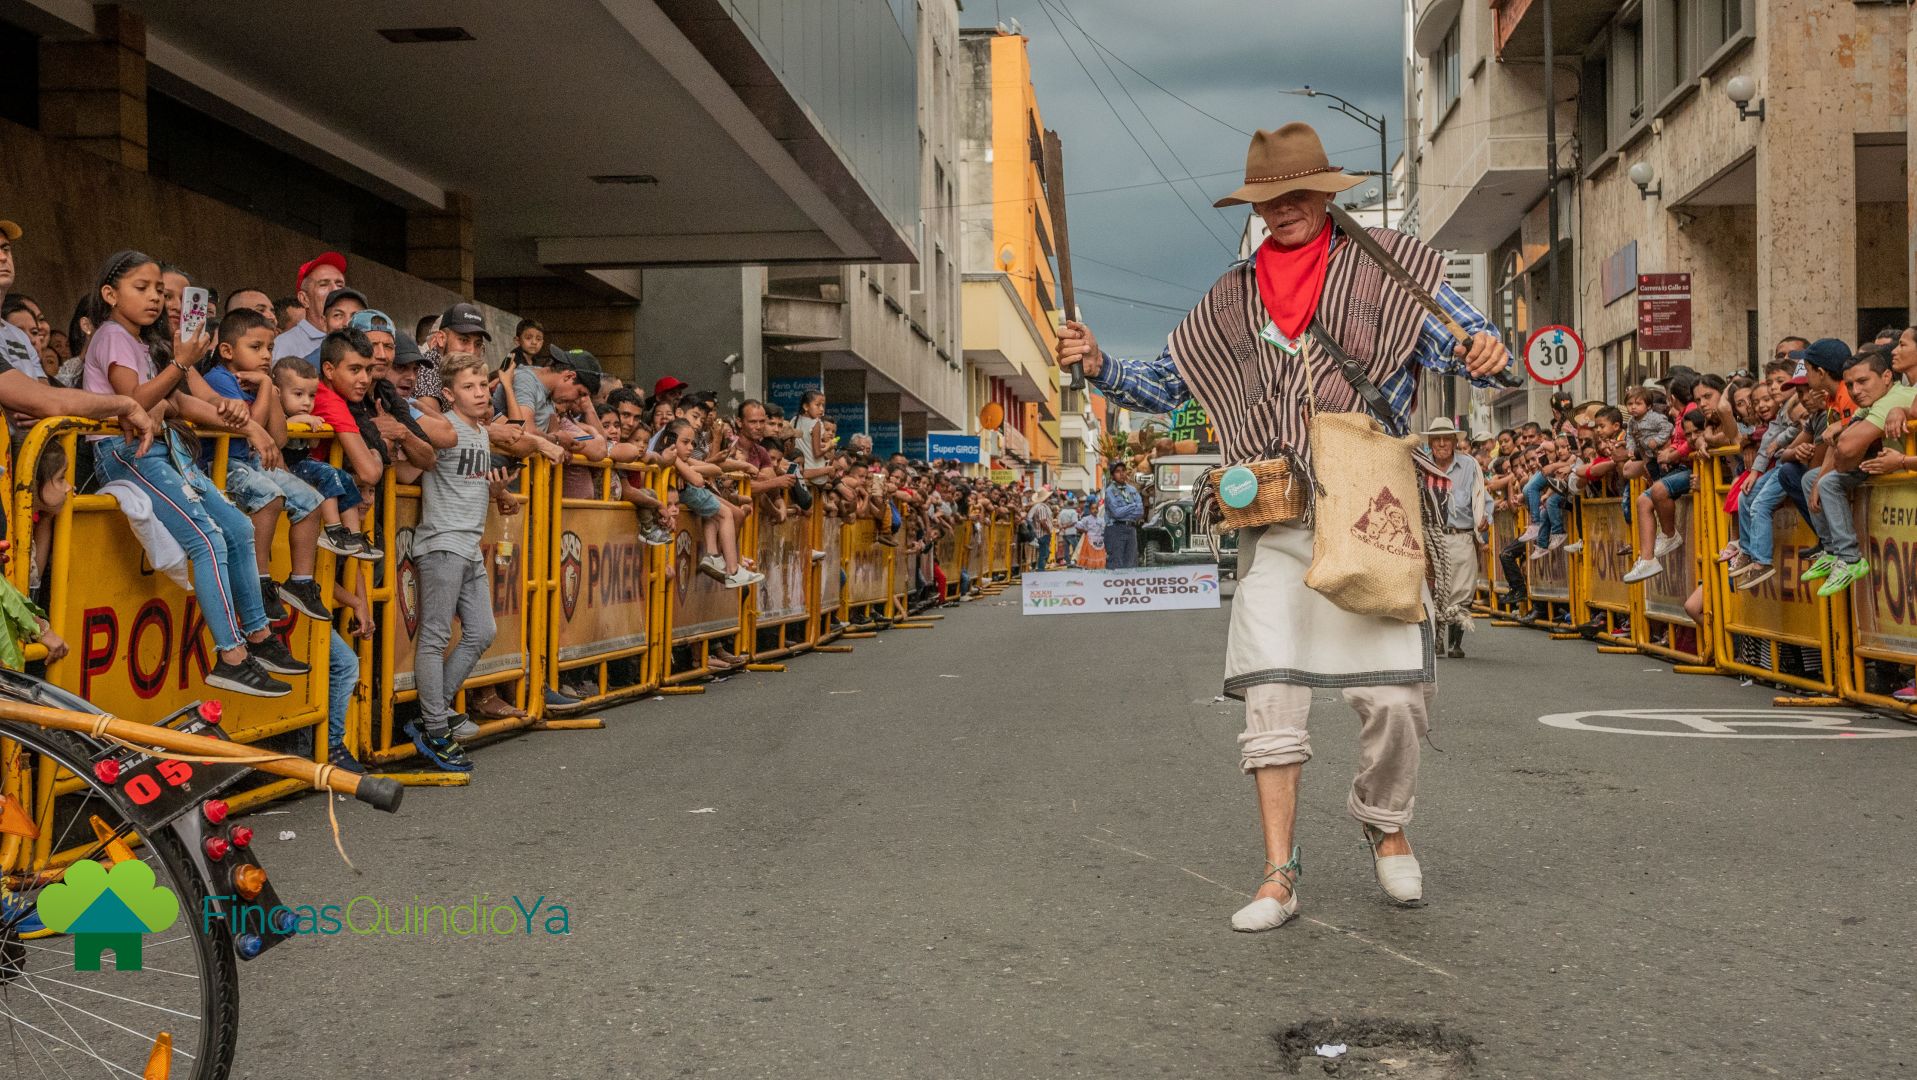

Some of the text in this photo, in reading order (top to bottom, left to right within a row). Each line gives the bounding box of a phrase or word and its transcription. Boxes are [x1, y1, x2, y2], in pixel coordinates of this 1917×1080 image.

[1667, 283, 1681, 291] Calle
[1540, 345, 1568, 367] 30
[587, 541, 646, 610] POKER
[1102, 577, 1189, 588] CONCURSO
[1121, 585, 1199, 596] AL MEJOR
[1031, 597, 1086, 608] YIPAO
[1103, 596, 1152, 605] YIPAO
